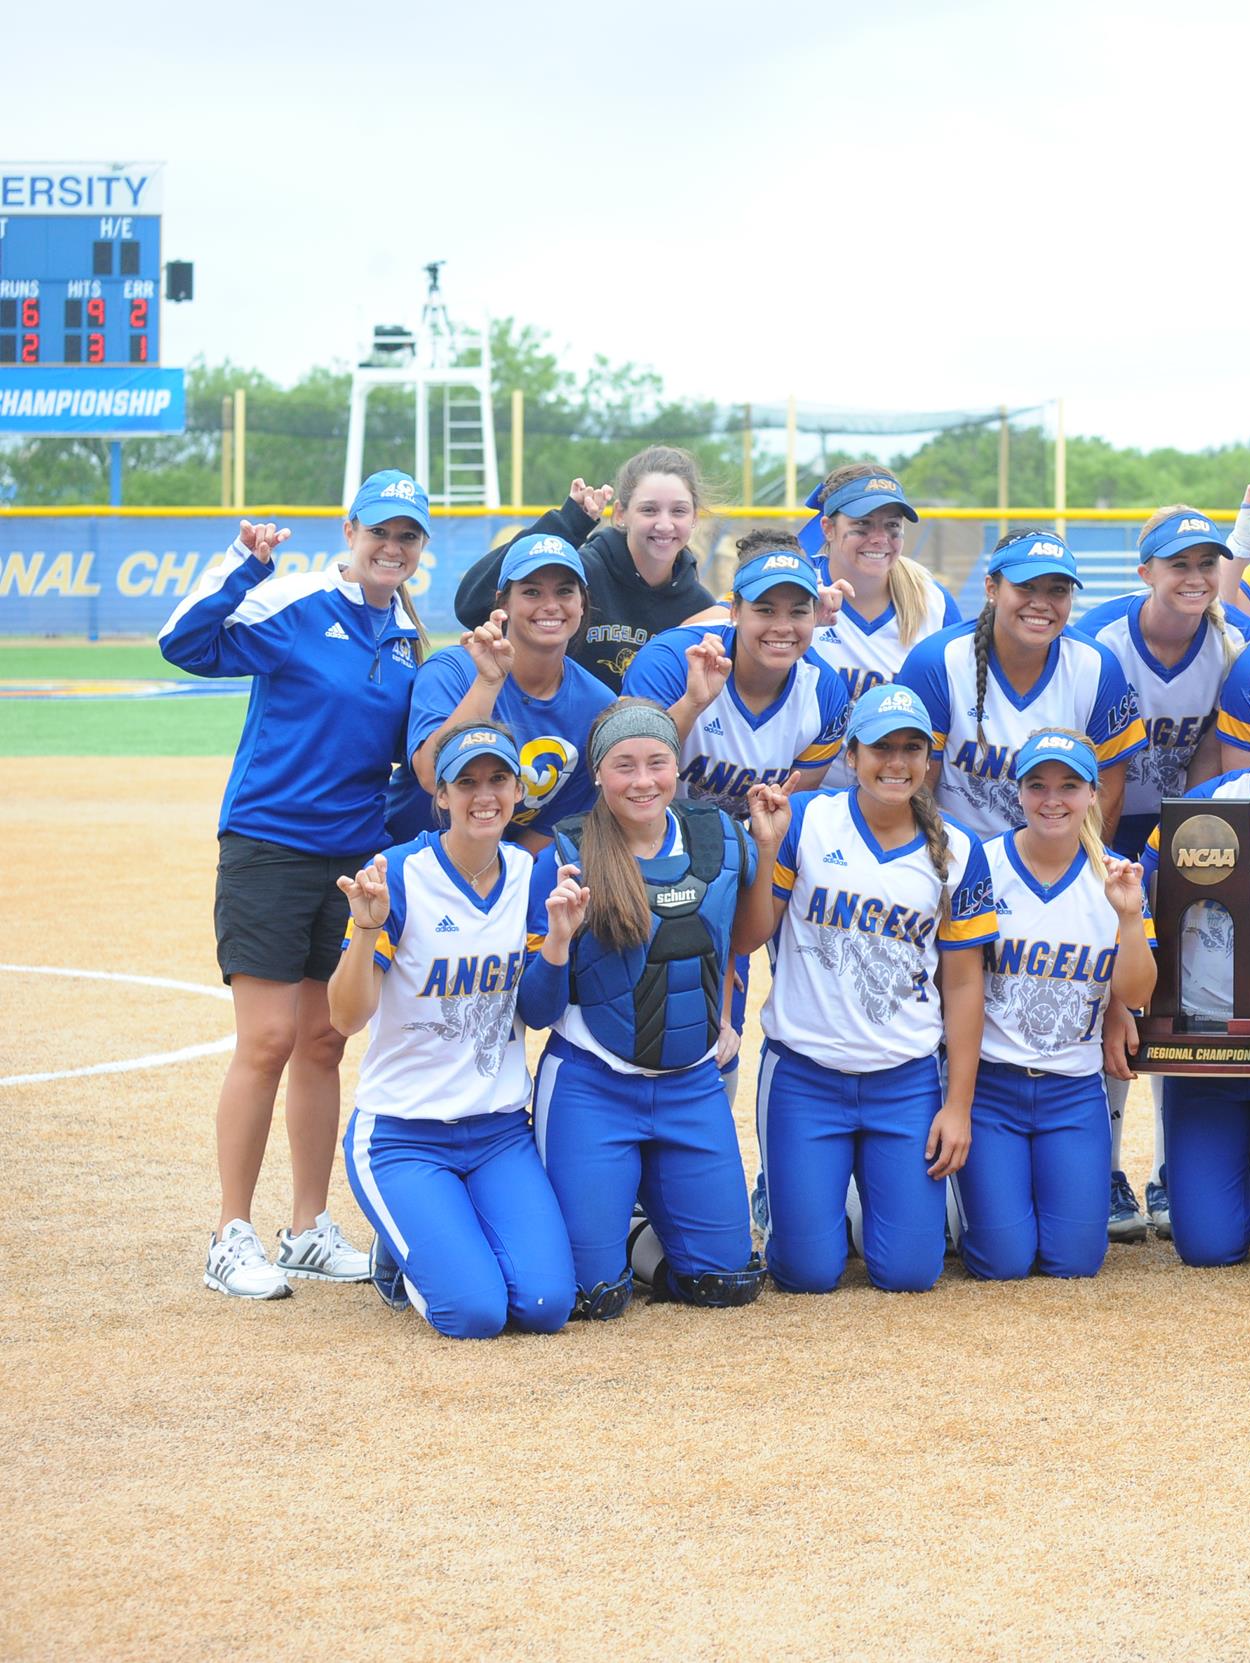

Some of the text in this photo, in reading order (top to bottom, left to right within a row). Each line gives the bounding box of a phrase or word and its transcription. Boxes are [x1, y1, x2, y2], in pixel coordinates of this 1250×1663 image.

[1, 176, 147, 207] ERSITY
[0, 280, 153, 298] RUNS HITS ERR
[22, 299, 147, 328] 6 9 2
[22, 333, 147, 362] 2 3 1
[864, 479, 896, 491] ASU
[1177, 518, 1210, 535] ASU
[1027, 541, 1064, 558] ASU
[762, 556, 799, 570] ASU
[0, 551, 99, 597] NAL
[586, 624, 647, 645] ANGELO
[880, 691, 913, 707] ASU
[878, 705, 915, 713] SOFTBALL
[459, 731, 496, 749] ASU
[1035, 736, 1074, 752] ASU
[822, 856, 848, 867] adidas
[1176, 847, 1236, 869] NCAA
[656, 888, 697, 906] schutt
[804, 885, 936, 949] ANGELO
[416, 949, 524, 998] ANGE
[1147, 1047, 1193, 1060] REGIONAL
